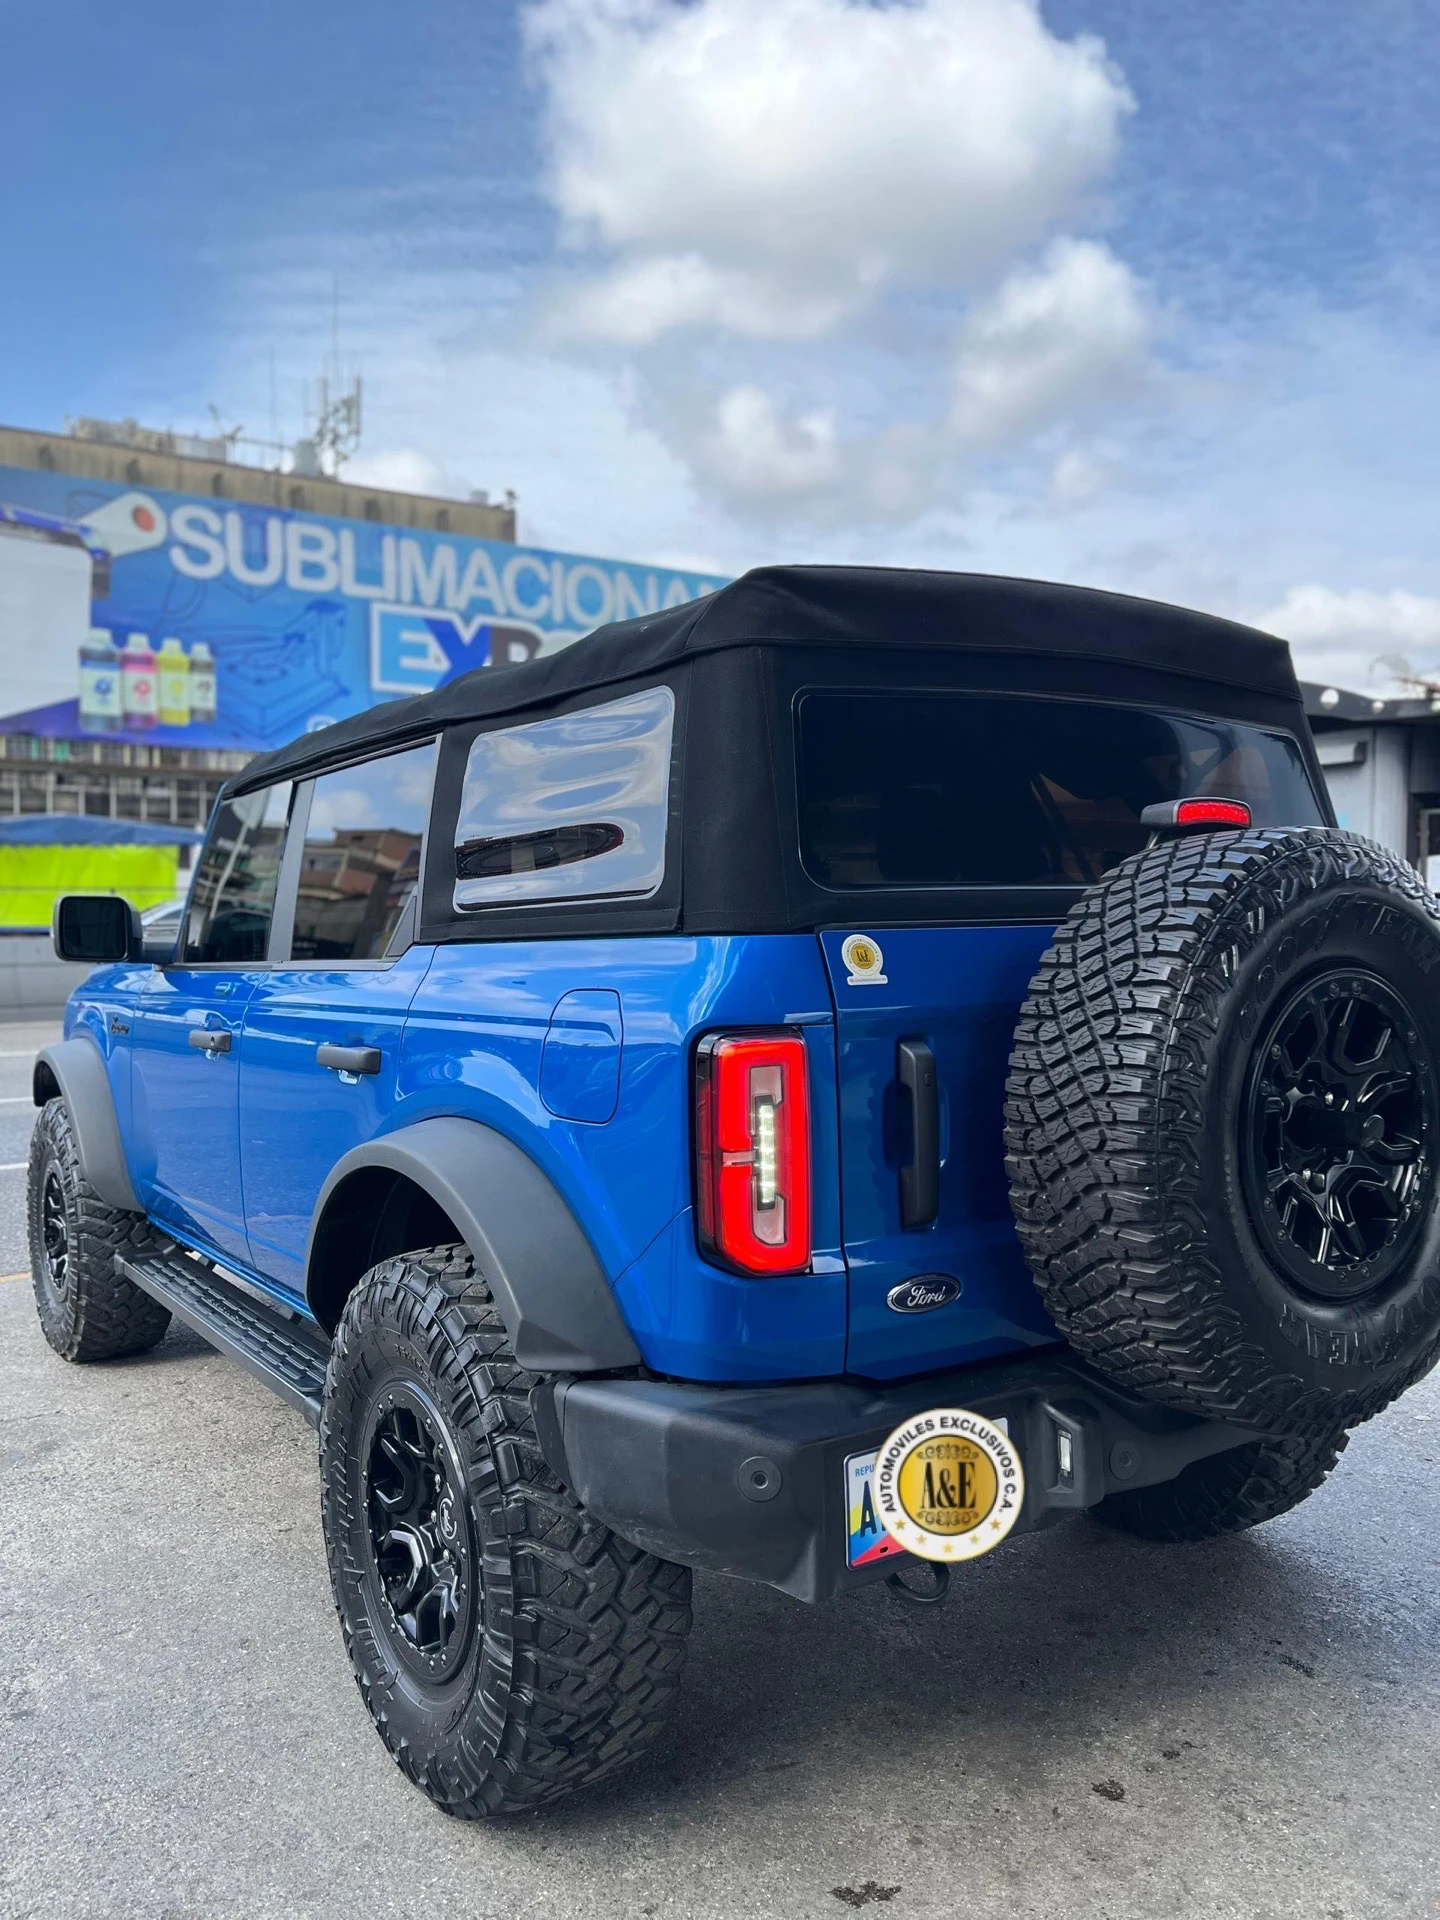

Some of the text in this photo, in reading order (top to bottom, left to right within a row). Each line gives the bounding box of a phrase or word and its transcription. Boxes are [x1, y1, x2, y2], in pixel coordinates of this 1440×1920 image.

[907, 1284, 946, 1307] Ford
[855, 1464, 877, 1477] REPU
[860, 1480, 886, 1538] A
